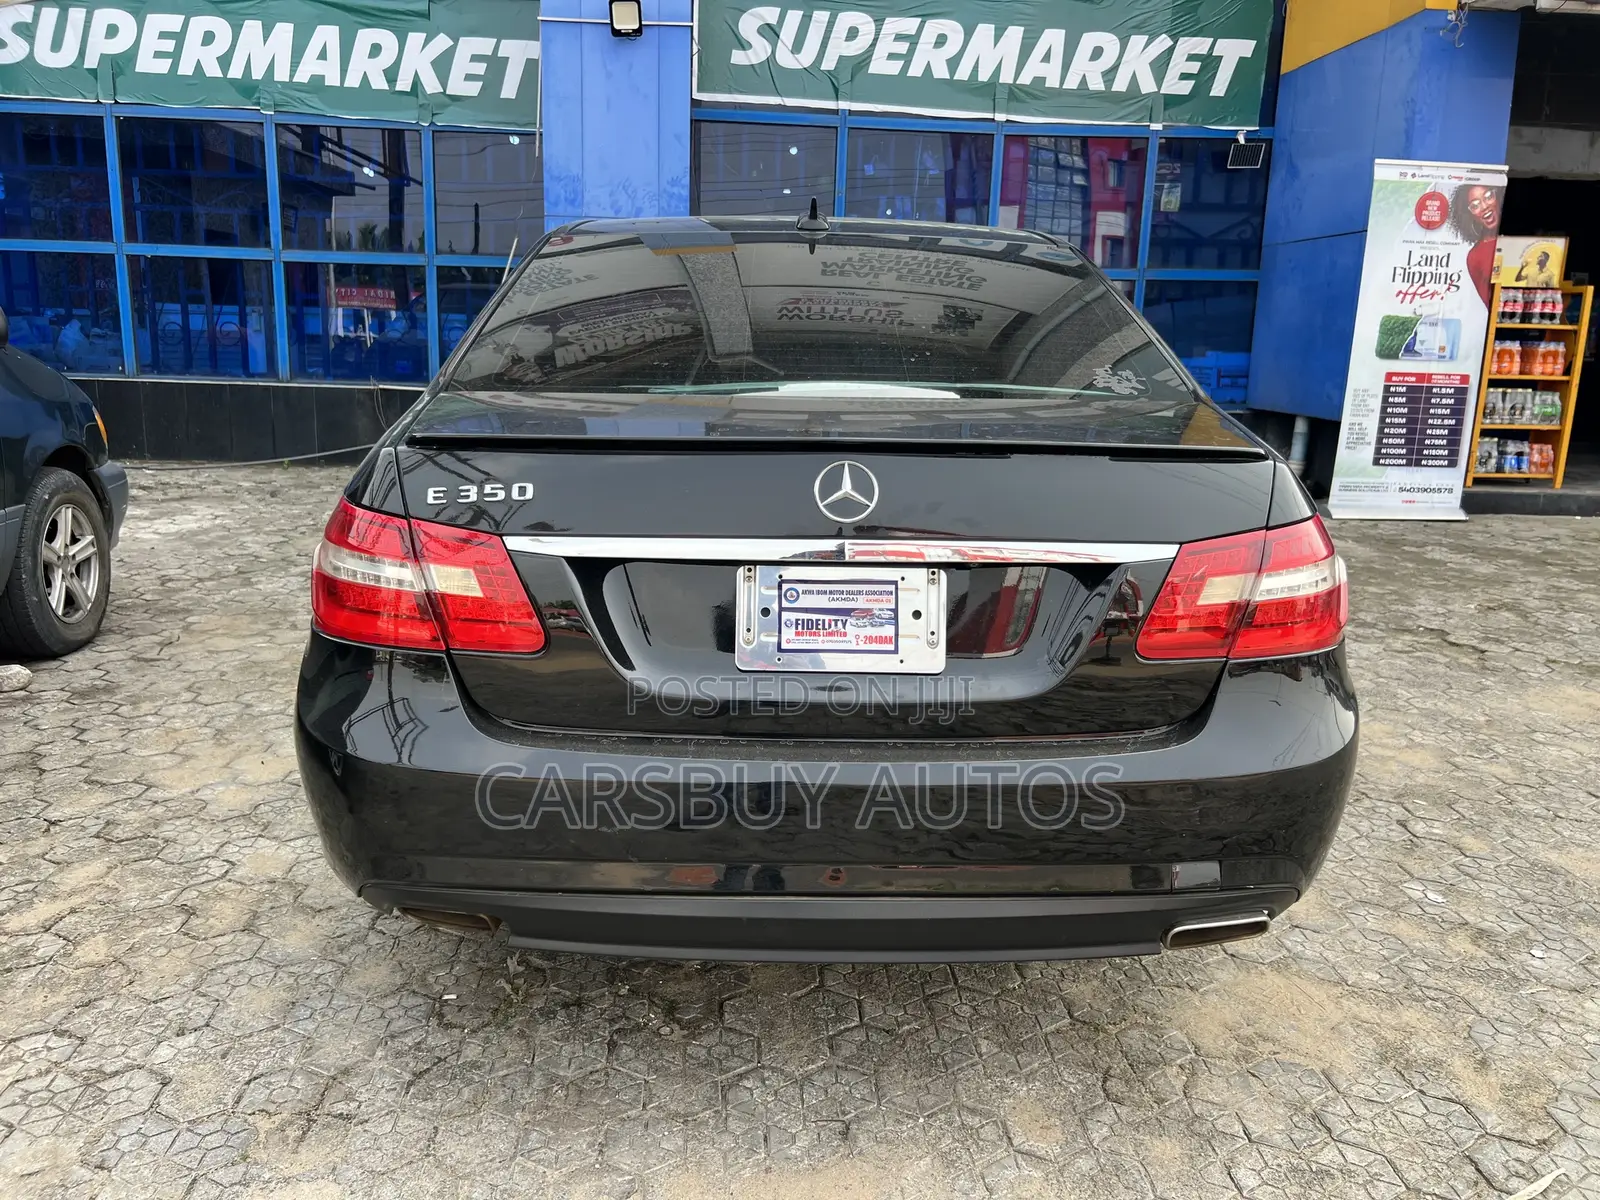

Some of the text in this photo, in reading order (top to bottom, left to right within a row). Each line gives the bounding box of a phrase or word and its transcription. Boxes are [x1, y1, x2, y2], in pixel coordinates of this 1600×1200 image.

[0, 4, 539, 100] SUPERMARKET
[731, 7, 1256, 97] SUPERMARKET
[1407, 250, 1451, 268] Land
[1392, 266, 1463, 293] Flipping
[426, 480, 536, 506] E 350
[795, 618, 848, 630] FIDELITY
[822, 630, 848, 638] LIMITED
